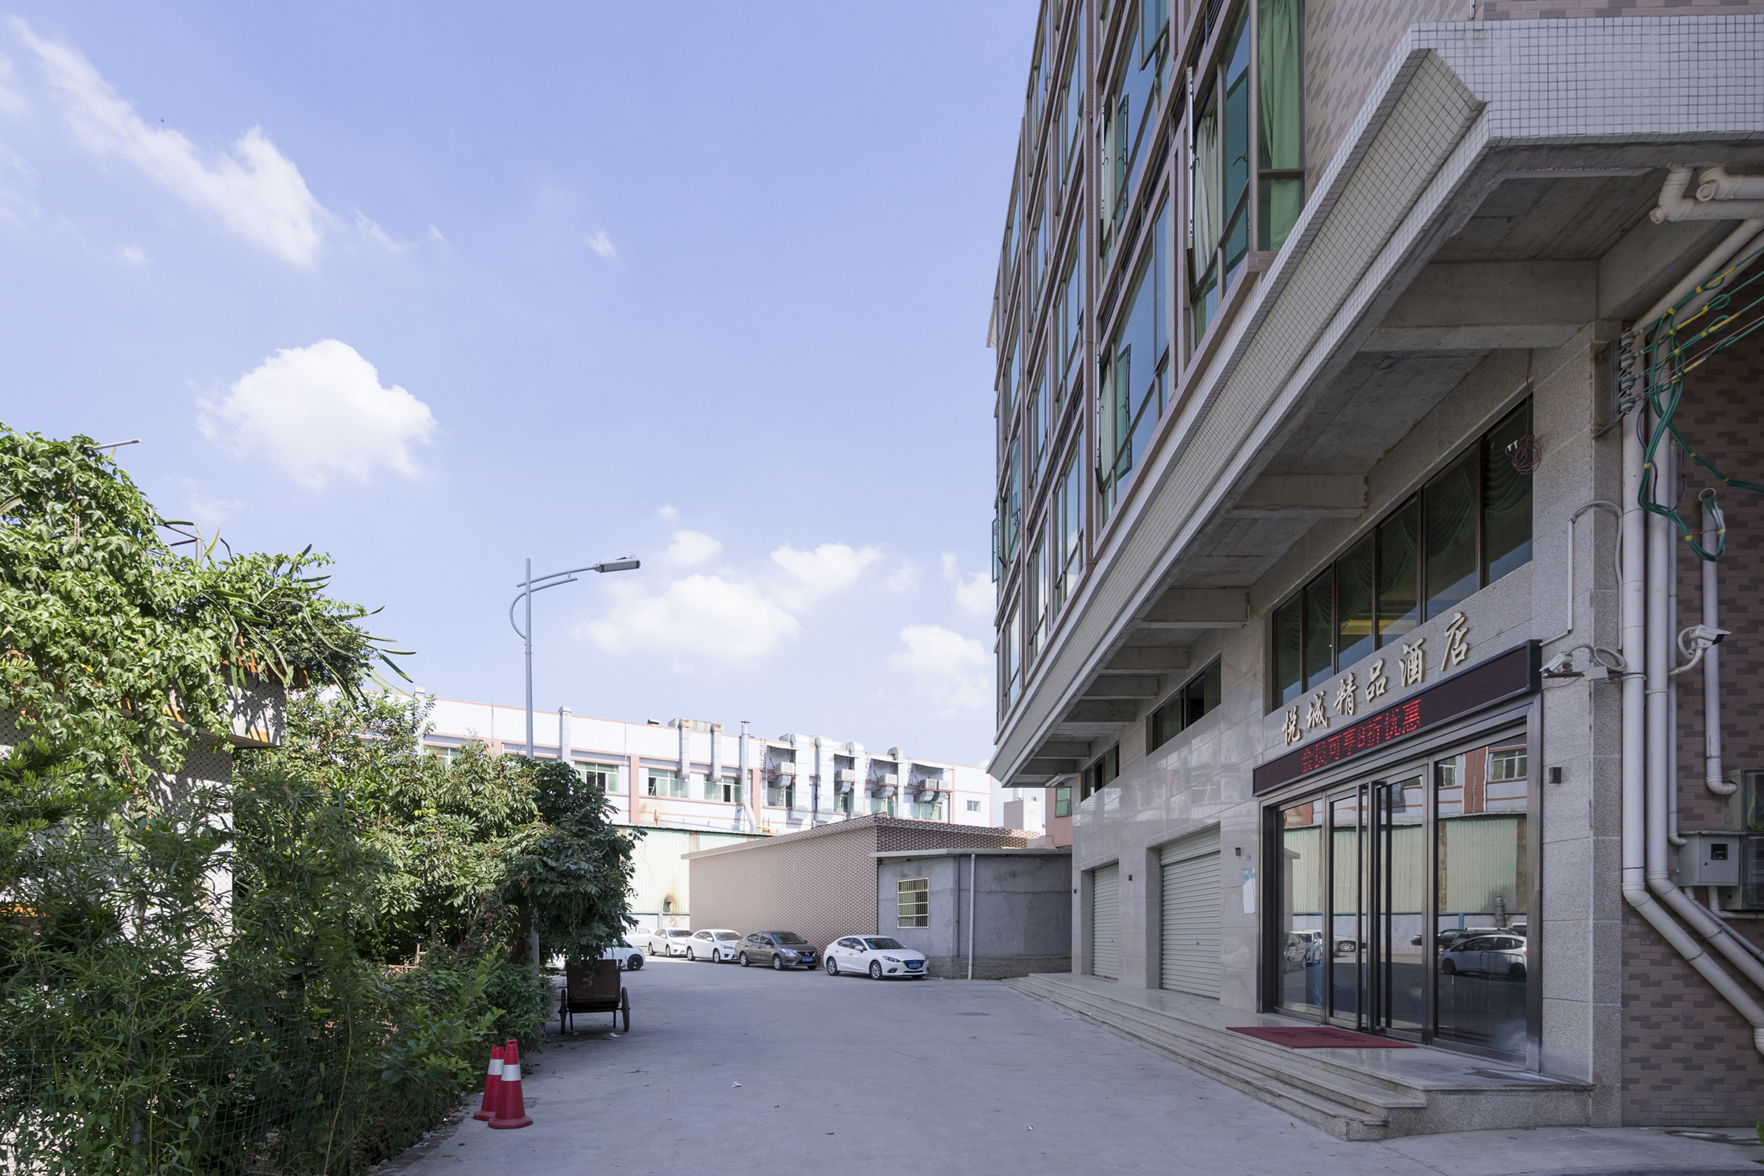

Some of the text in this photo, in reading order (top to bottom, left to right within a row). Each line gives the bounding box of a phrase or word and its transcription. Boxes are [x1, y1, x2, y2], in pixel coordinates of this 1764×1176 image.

[1282, 611, 1469, 746] 悦城精品酒店
[1301, 699, 1421, 773] 会员可享8折优惠
